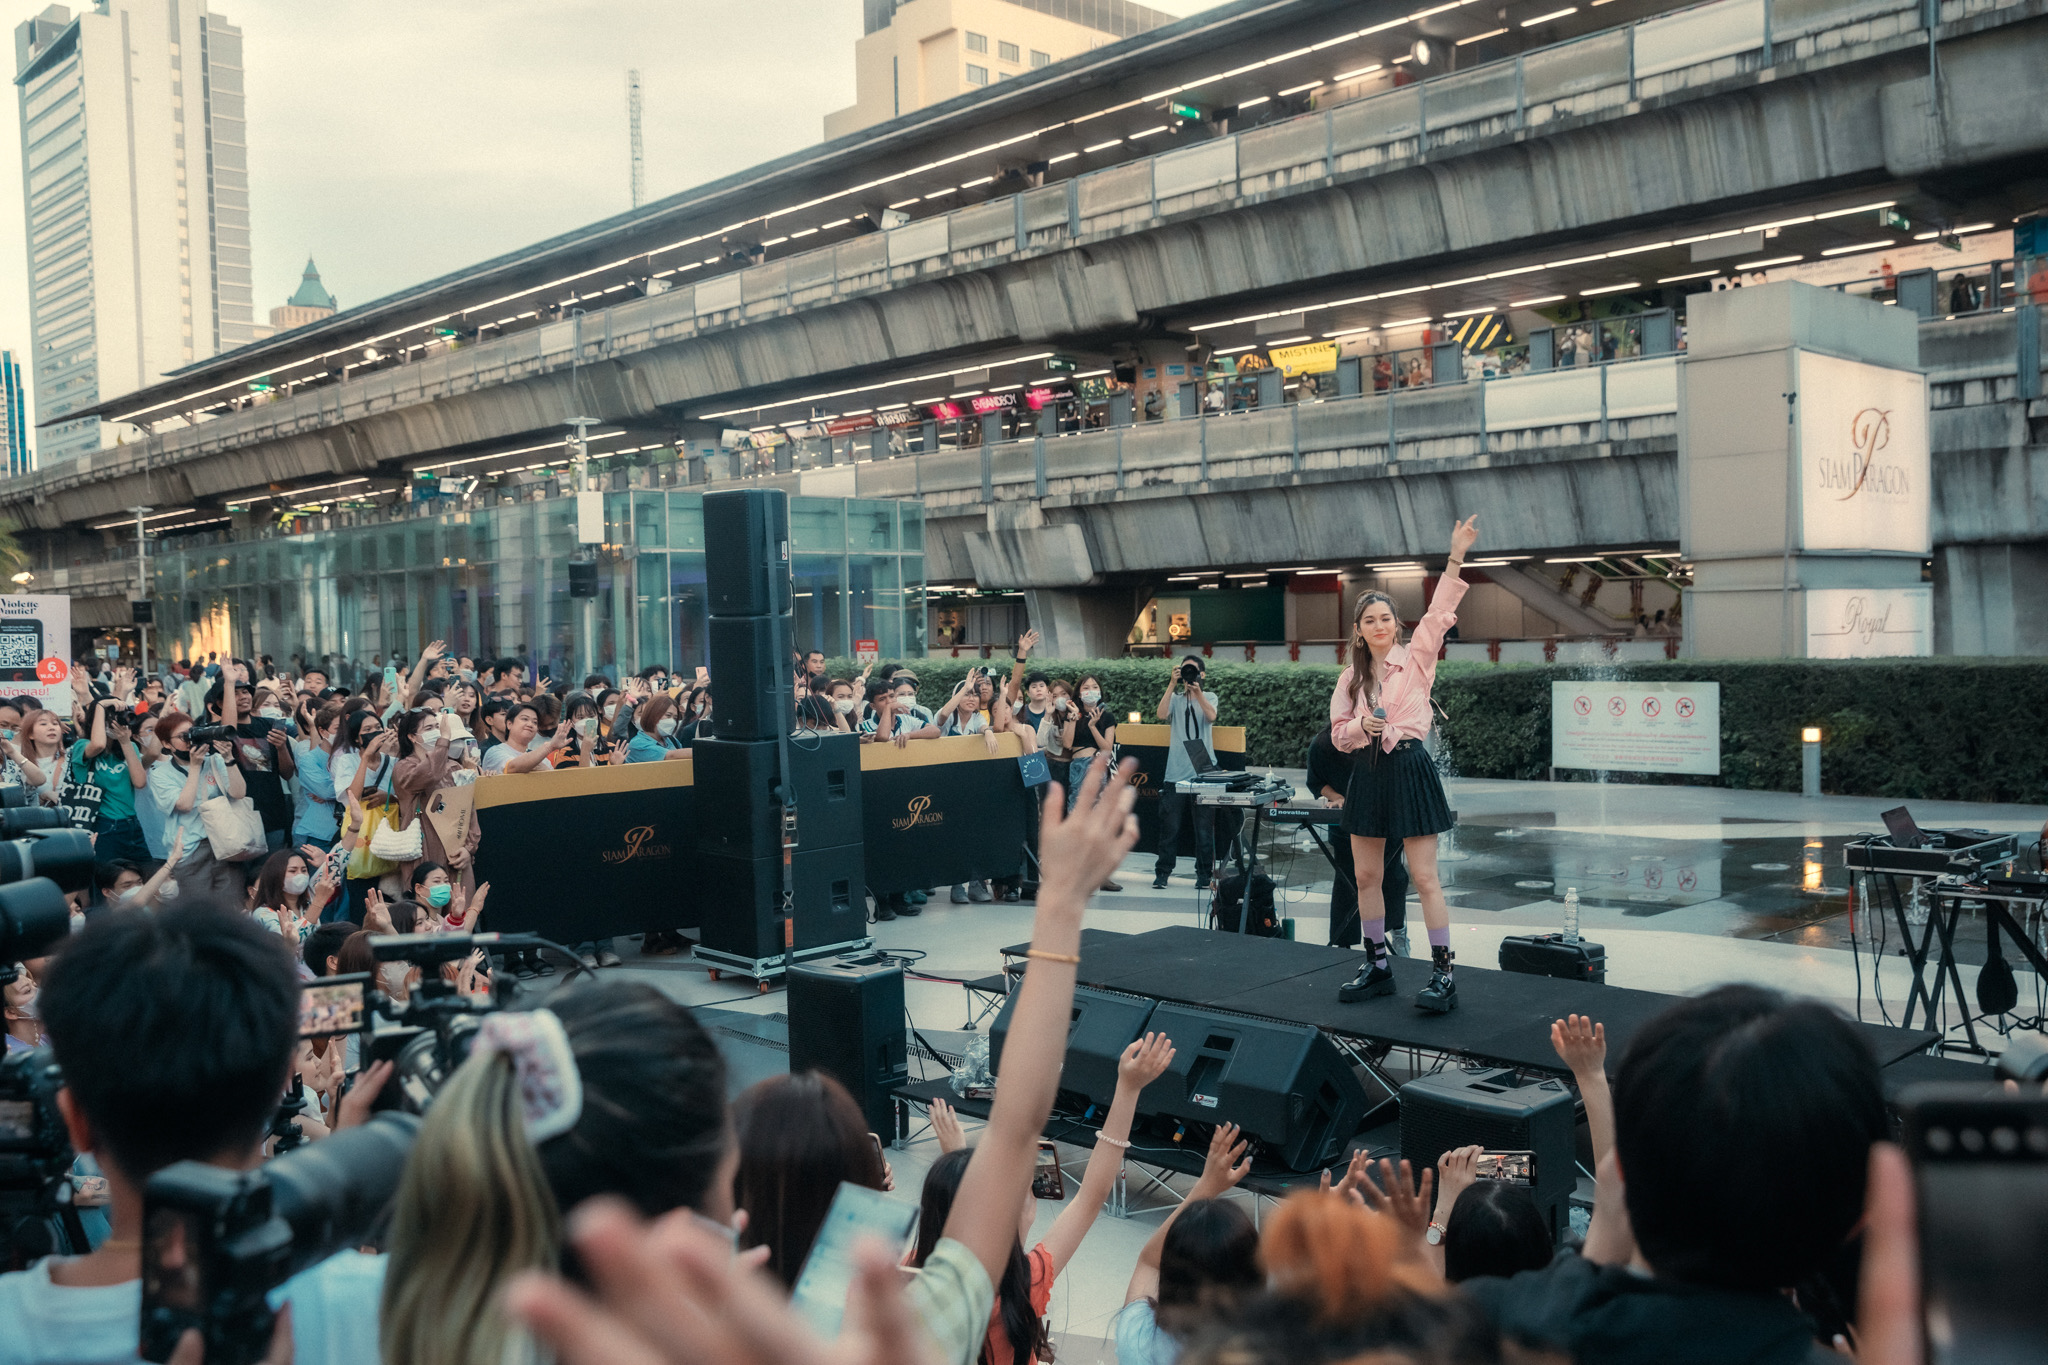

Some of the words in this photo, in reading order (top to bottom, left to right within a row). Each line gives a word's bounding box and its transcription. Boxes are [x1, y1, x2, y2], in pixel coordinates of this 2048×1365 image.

[1279, 344, 1331, 358] MISTINE
[971, 393, 1017, 410] EVEANDBOY
[1819, 457, 1853, 490] SIAM
[0, 598, 39, 608] Violette
[1844, 596, 1892, 645] Royal
[47, 661, 57, 672] 6
[892, 817, 910, 829] SIAM
[602, 849, 626, 863] SIAM
